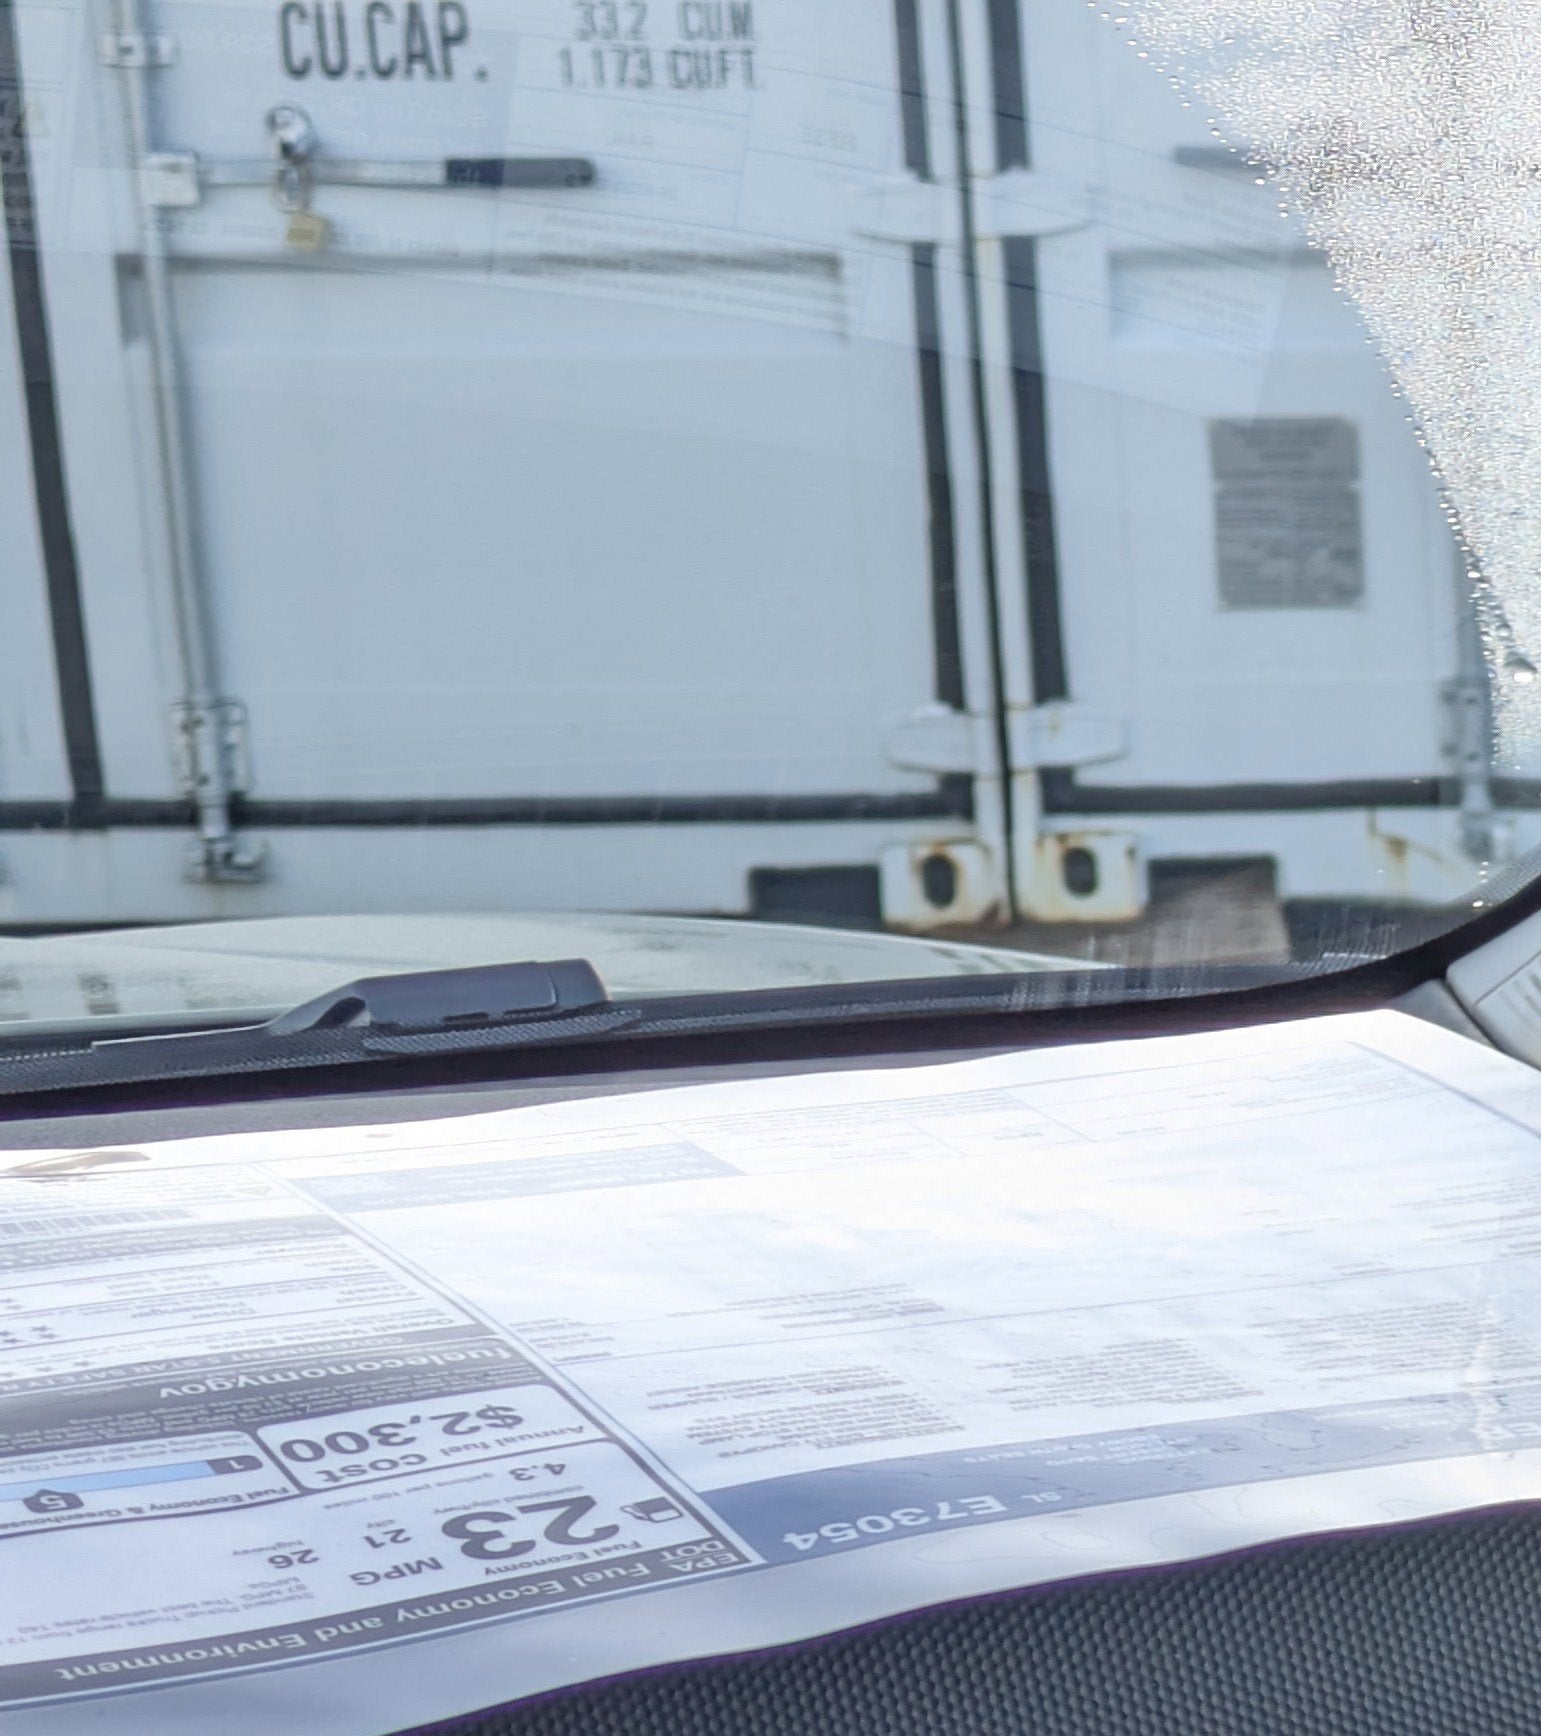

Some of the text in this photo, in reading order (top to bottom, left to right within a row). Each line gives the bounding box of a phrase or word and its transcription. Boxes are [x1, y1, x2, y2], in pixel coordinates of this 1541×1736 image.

[223, 1337, 403, 1362] GOVERNMENT
[280, 1404, 524, 1463] $2,300
[315, 1425, 584, 1484] Annual fuel cost
[507, 1462, 567, 1482] 4.3
[40, 1494, 66, 1511] 5
[148, 1493, 242, 1514] Economy
[246, 1486, 289, 1500] Fuel
[1020, 1491, 1062, 1504] SL
[126, 1505, 144, 1516] &
[441, 1494, 620, 1561] 23
[781, 1494, 1008, 1551] E73054
[361, 1527, 411, 1549] 21
[267, 1549, 320, 1569] 26
[482, 1540, 642, 1577] Fuel Economy
[657, 1538, 724, 1562] DOT
[349, 1557, 443, 1586] MPG
[668, 1552, 739, 1573] EPA
[53, 1562, 650, 1681] Fuel Economy and Environment
